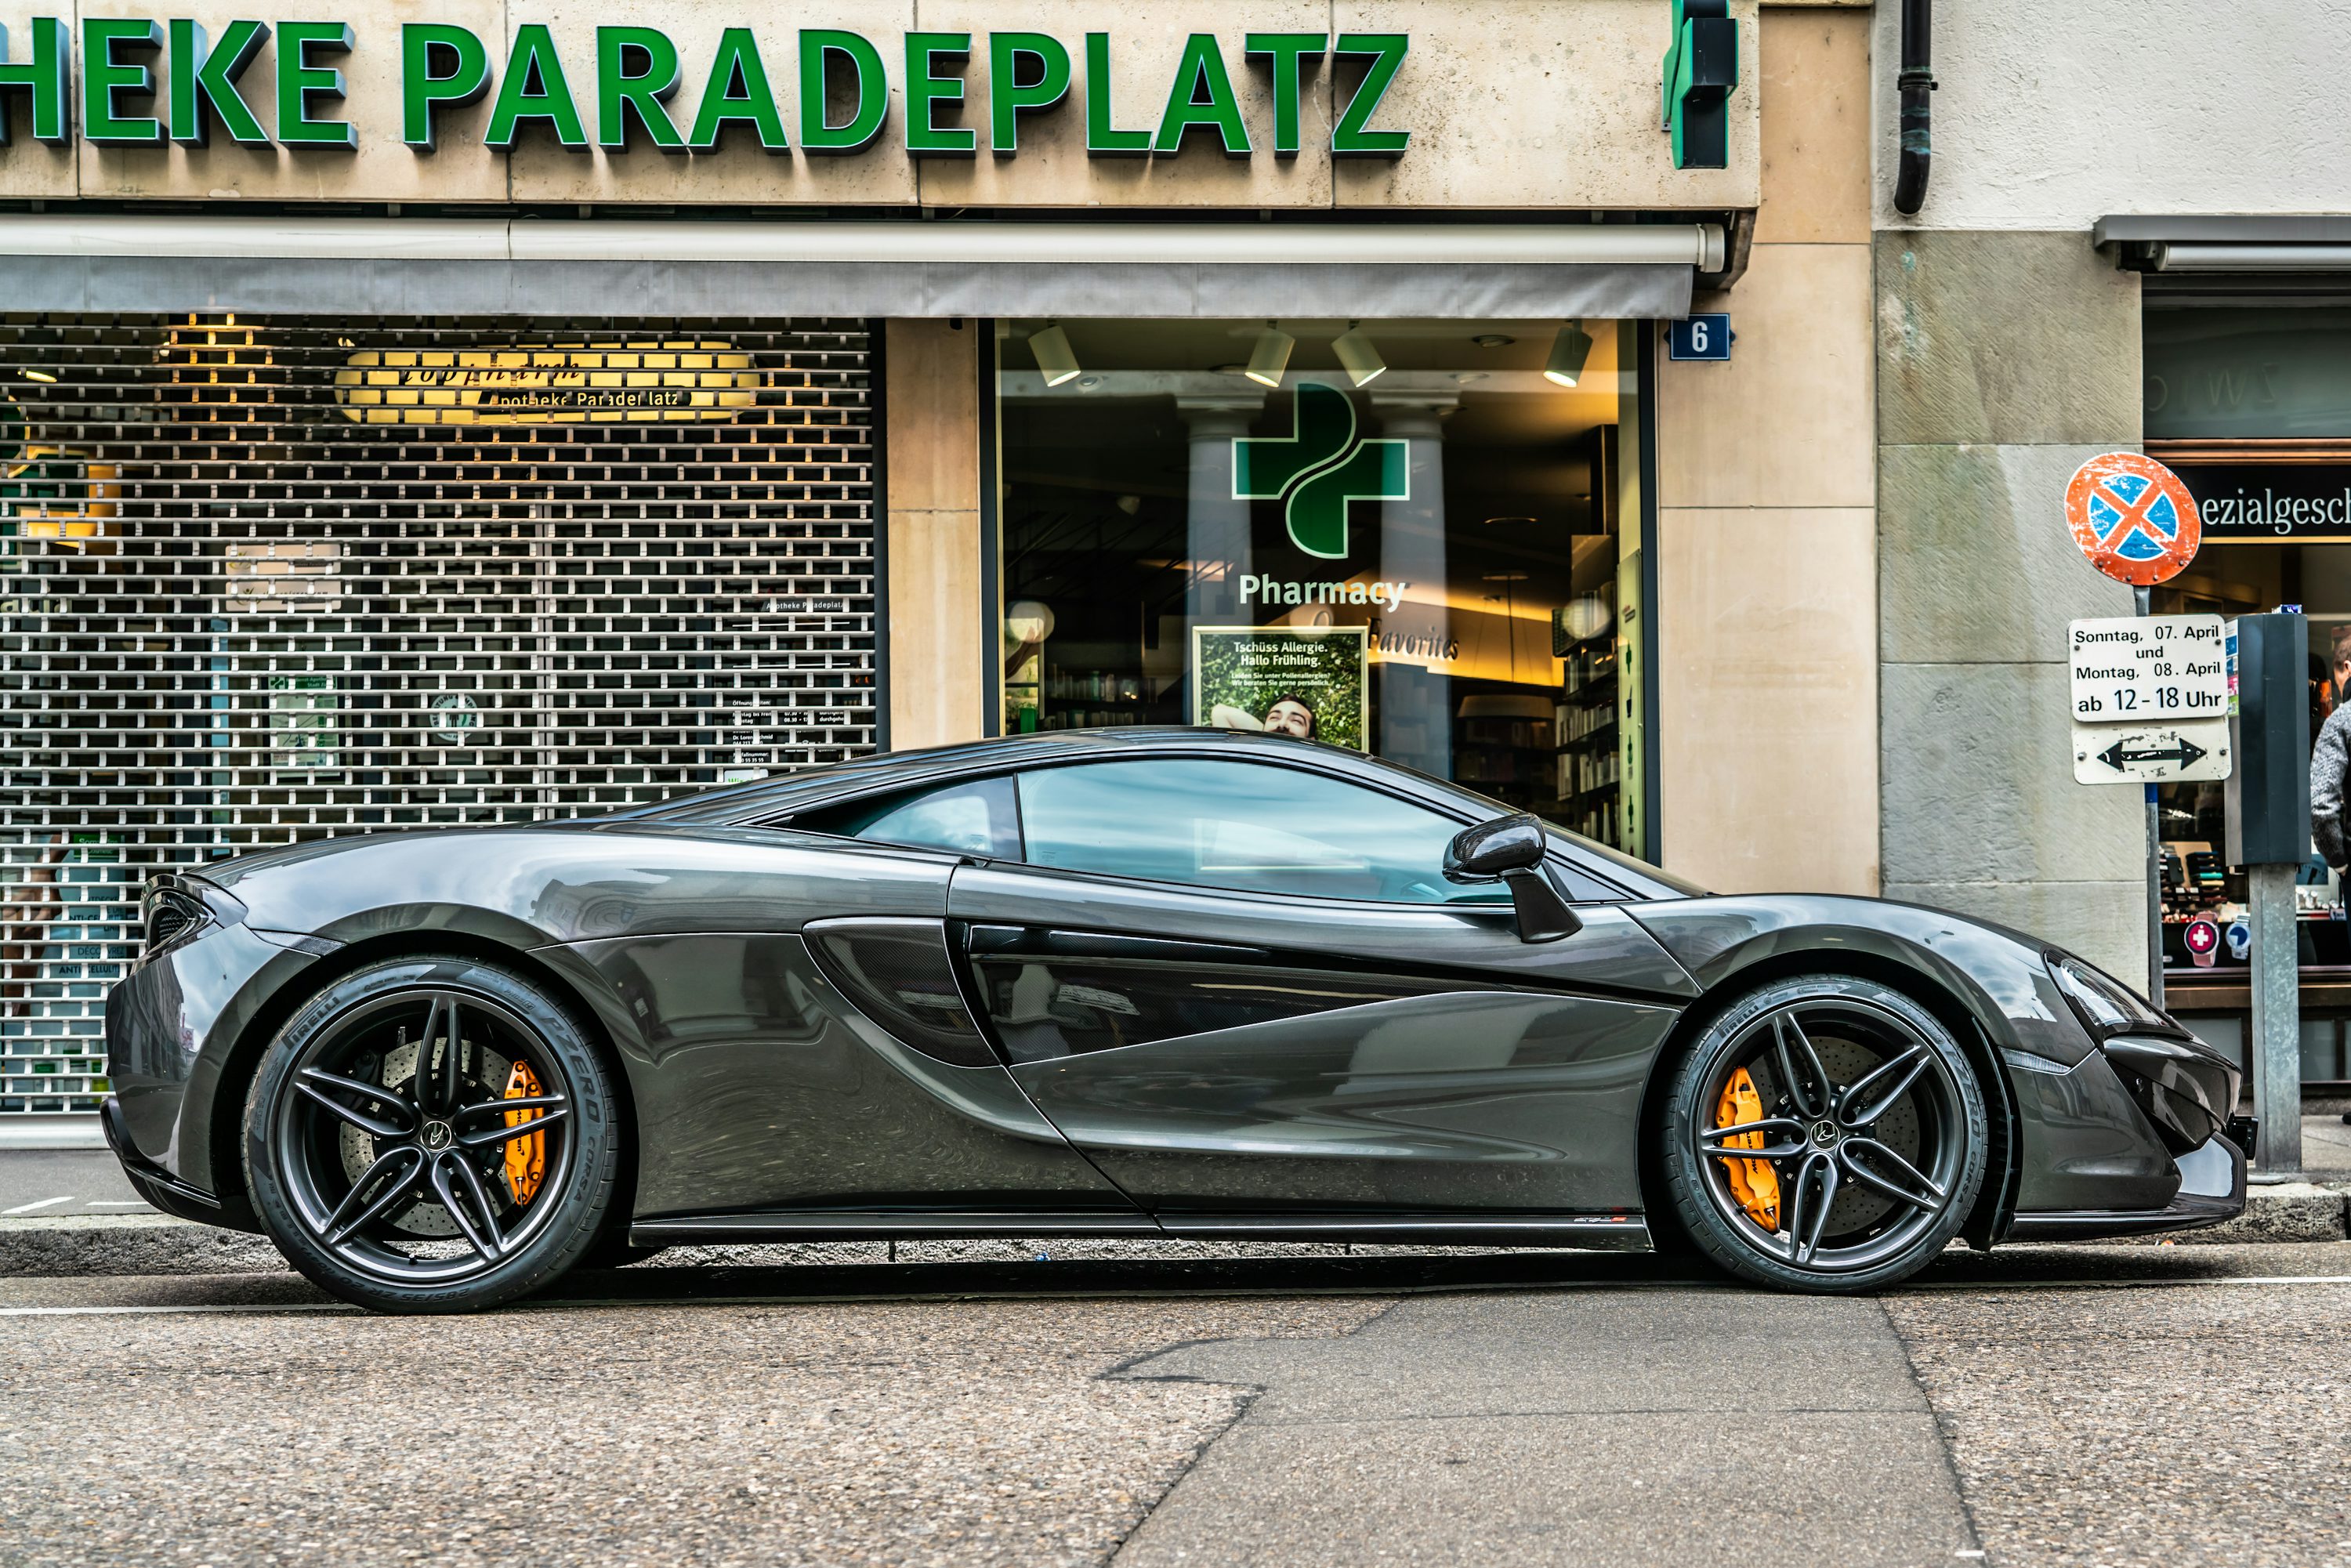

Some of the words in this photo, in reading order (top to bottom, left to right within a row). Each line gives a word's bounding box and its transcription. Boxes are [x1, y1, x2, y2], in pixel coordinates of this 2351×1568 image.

[401, 23, 1411, 159] PARADEPLATZ
[1692, 320, 1708, 353] 6
[1240, 574, 1406, 613] Pharmacy
[1233, 641, 1278, 653] Tschüss
[1281, 641, 1328, 654] Allergie.
[1367, 617, 1459, 661] Favorites
[2075, 629, 2143, 644] Sonntag,
[2155, 626, 2177, 639] 07.
[2184, 625, 2219, 642] April
[1241, 654, 1270, 666] Hallo
[1273, 654, 1321, 668] Frühling.
[2135, 646, 2164, 659] und
[2076, 667, 2139, 680] Montag,
[2154, 663, 2179, 677] 08.
[2186, 661, 2221, 677] April
[2078, 695, 2102, 712] ab
[2186, 691, 2222, 708] Uhr
[281, 991, 340, 1050] PIRELLI
[1717, 1001, 1759, 1038] PIRELLI
[574, 1136, 596, 1201] CORSA
[1957, 1150, 1976, 1204] CORSA
